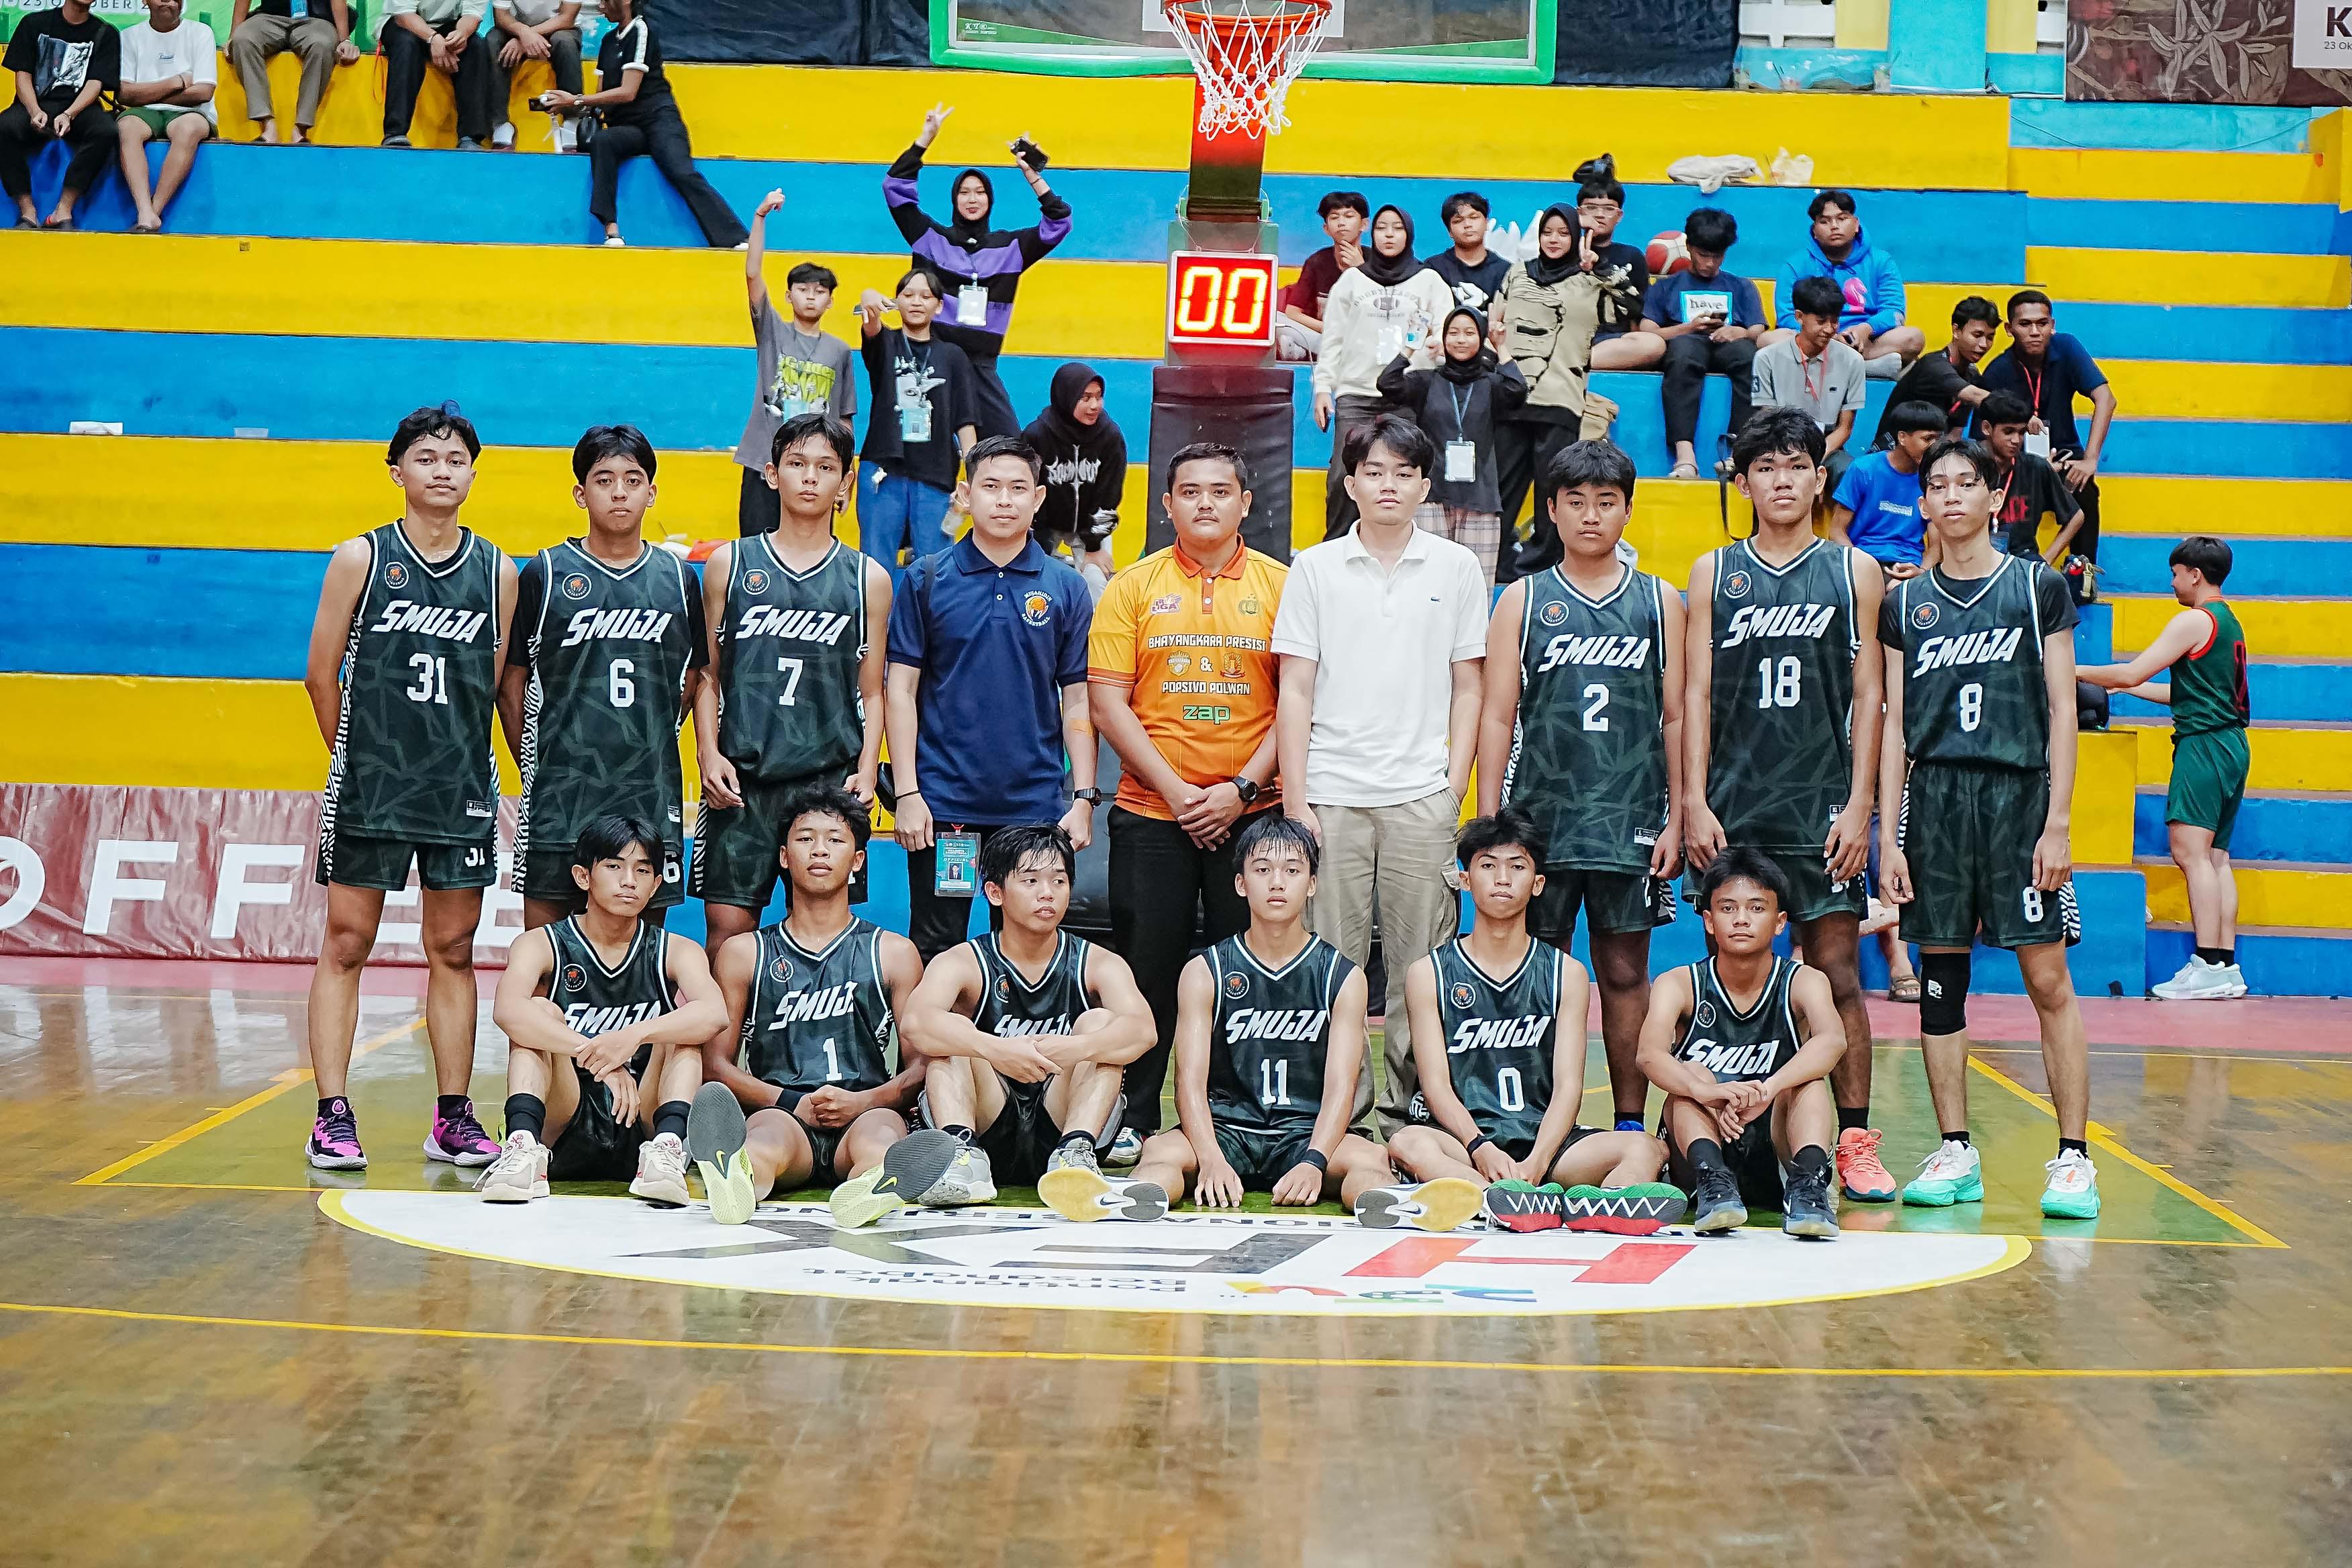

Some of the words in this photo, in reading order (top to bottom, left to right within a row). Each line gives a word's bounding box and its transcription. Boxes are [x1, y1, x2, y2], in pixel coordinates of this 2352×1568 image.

[2324, 41, 2336, 50] 23
[1176, 266, 1268, 334] 00
[1689, 298, 1724, 309] have
[1024, 590, 1052, 602] MUJAHIDIN
[371, 600, 488, 644] SMUJA
[560, 607, 673, 647] SMUJA
[735, 604, 851, 645] SMUJA
[1721, 603, 1836, 648] SMUJA
[1148, 634, 1224, 649] BHAYANGKARA
[1225, 636, 1267, 652] PRESISI
[1537, 633, 1651, 672] SMUJA
[1912, 627, 2023, 679] SMUJA
[407, 652, 448, 705] 31
[609, 658, 635, 707] 6
[777, 657, 803, 706] 7
[1199, 656, 1214, 672] &
[1759, 656, 1801, 709] 18
[1162, 681, 1207, 694] POPSIVO
[1210, 681, 1251, 695] POLWAN
[1583, 683, 1610, 732] 2
[1959, 683, 1983, 732] 8
[1183, 705, 1230, 725] zap
[663, 850, 680, 883] 6
[2022, 885, 2043, 923] 8
[1226, 1008, 1330, 1044] SMUJA
[1447, 1015, 1551, 1054] SMUJA
[822, 1038, 843, 1081] 1
[1686, 1038, 1780, 1075] SMUJA
[1261, 1059, 1291, 1106] 11
[1498, 1067, 1525, 1112] 0
[803, 1268, 1188, 1285] Bersahabat
[846, 1276, 1188, 1292] Pontianak
